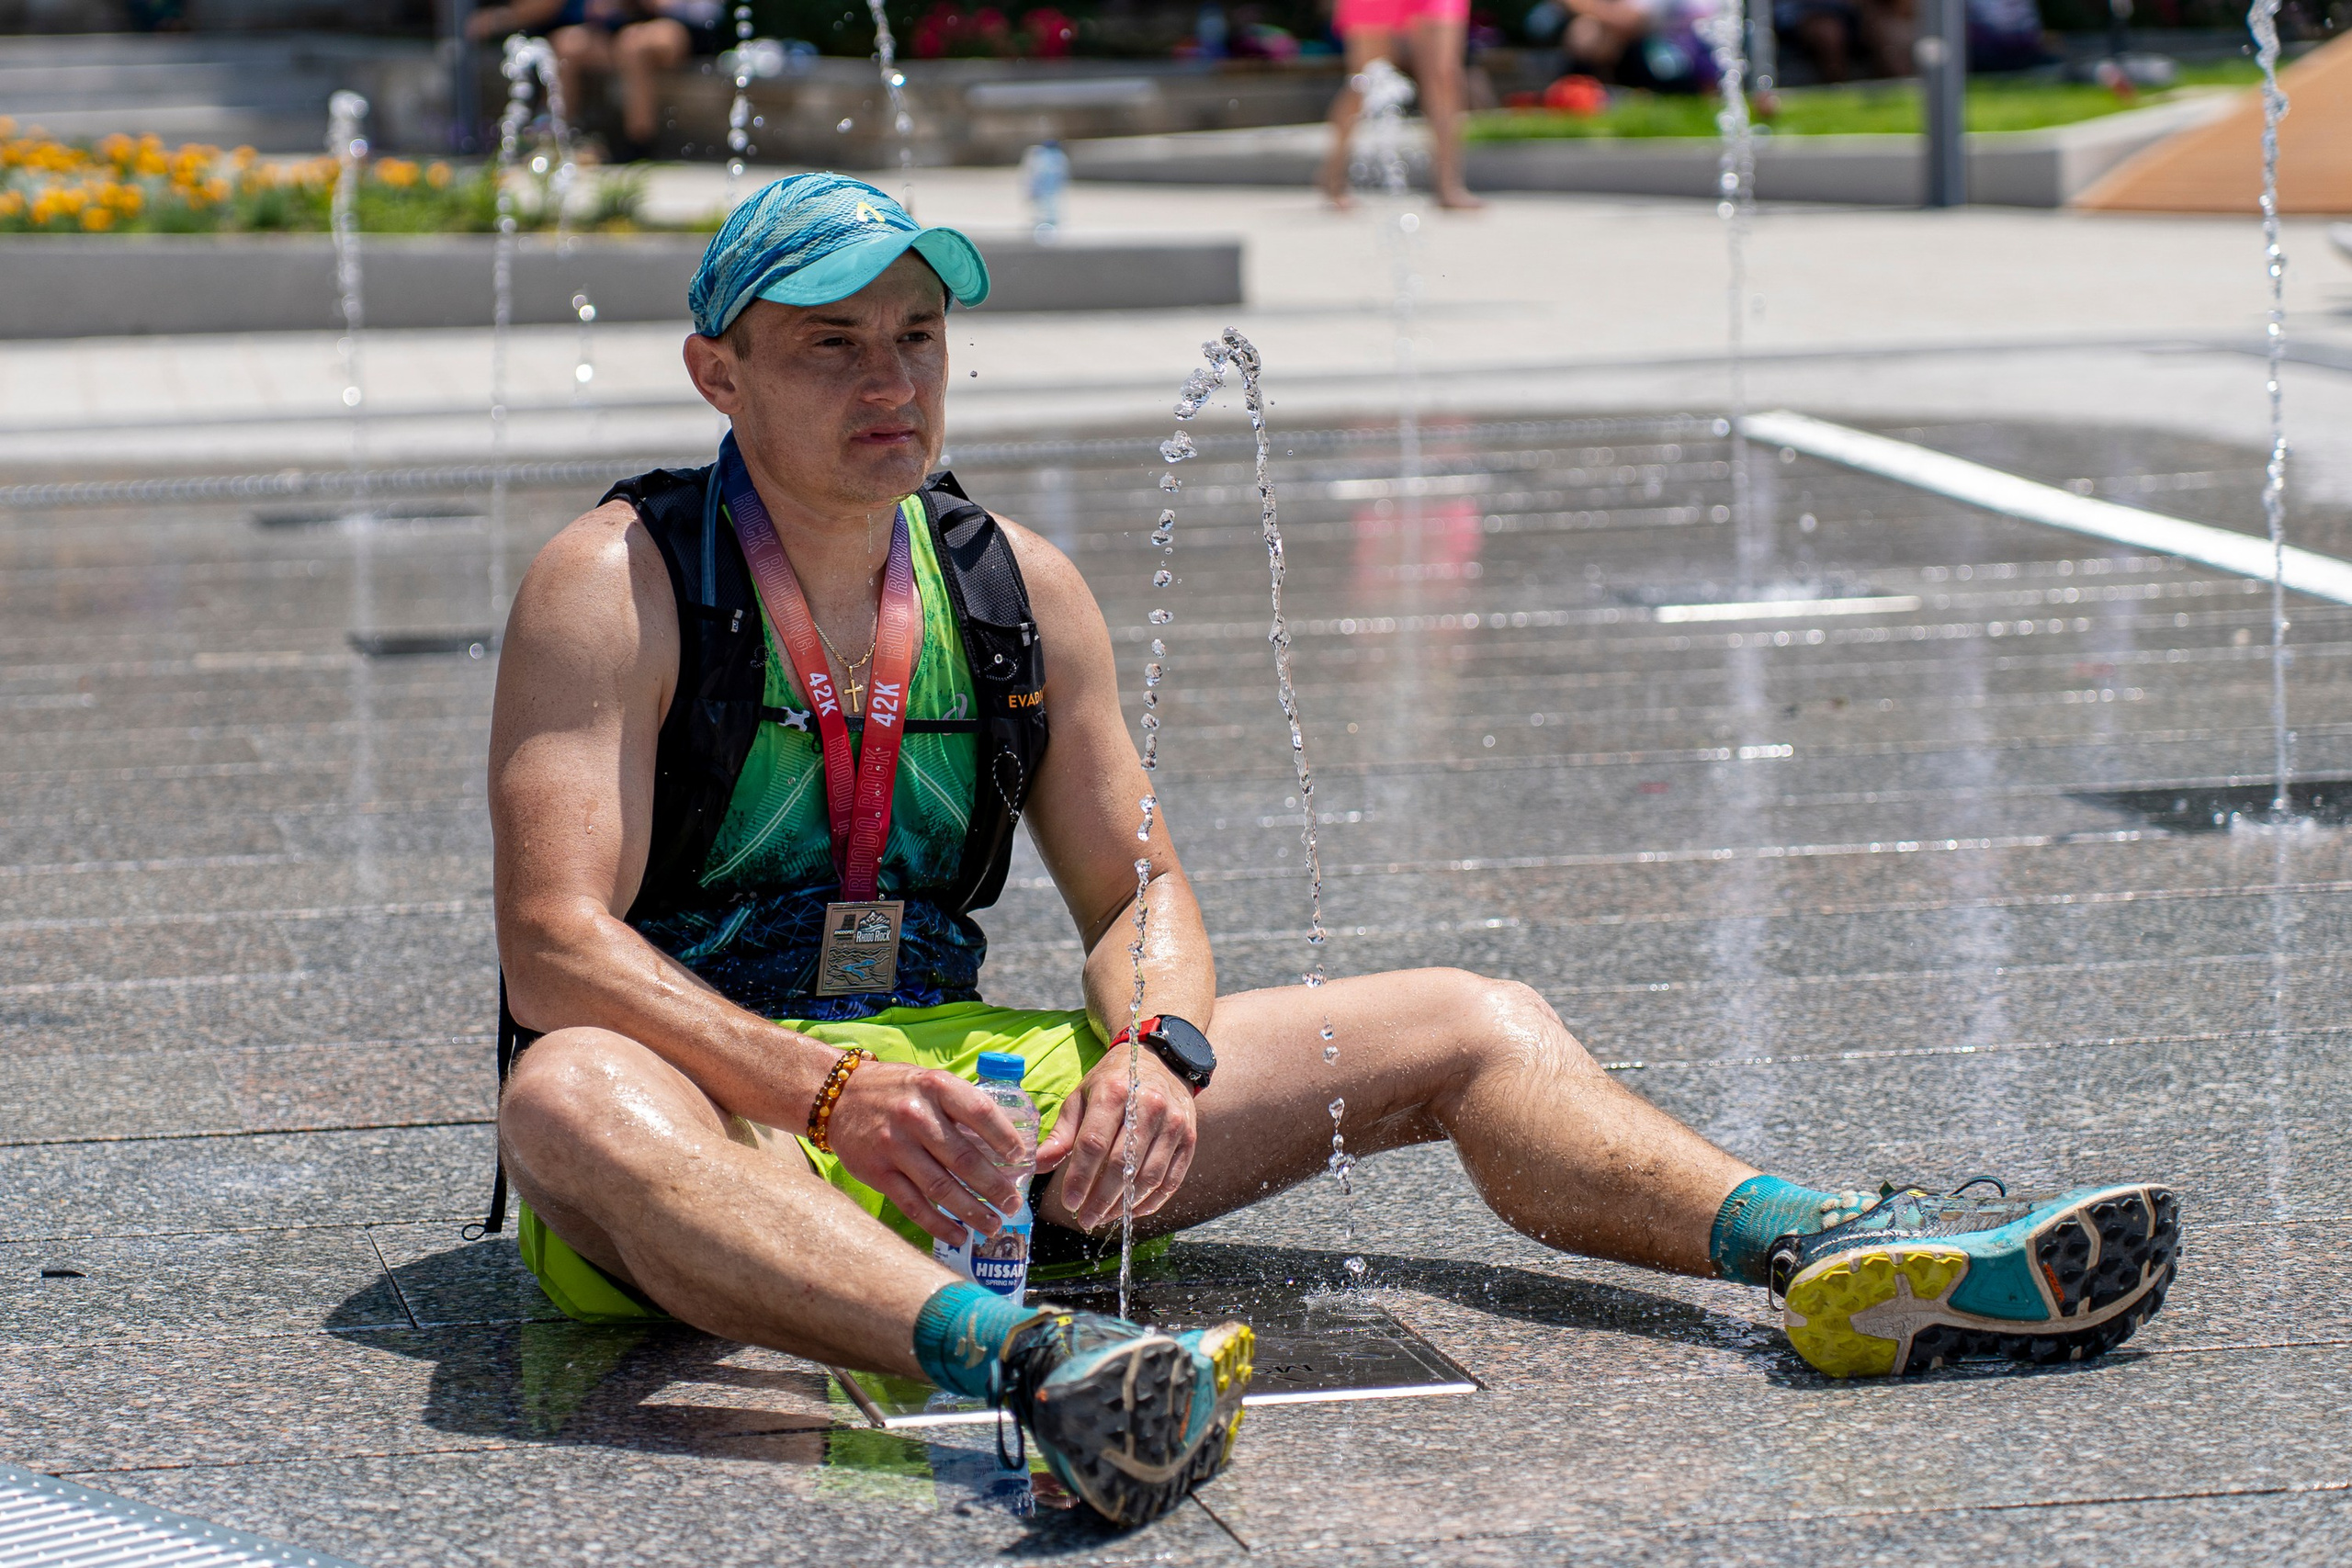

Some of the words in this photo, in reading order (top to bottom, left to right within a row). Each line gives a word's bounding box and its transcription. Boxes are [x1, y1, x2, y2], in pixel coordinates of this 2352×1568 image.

[732, 491, 775, 554] ROCK
[756, 553, 815, 652] RUNNING
[879, 599, 908, 660] ROCK
[809, 672, 838, 716] 42K
[871, 680, 900, 728] 42K
[858, 748, 891, 810] ROCK
[848, 818, 882, 892] RHODO
[976, 1263, 1024, 1278] HISSAR
